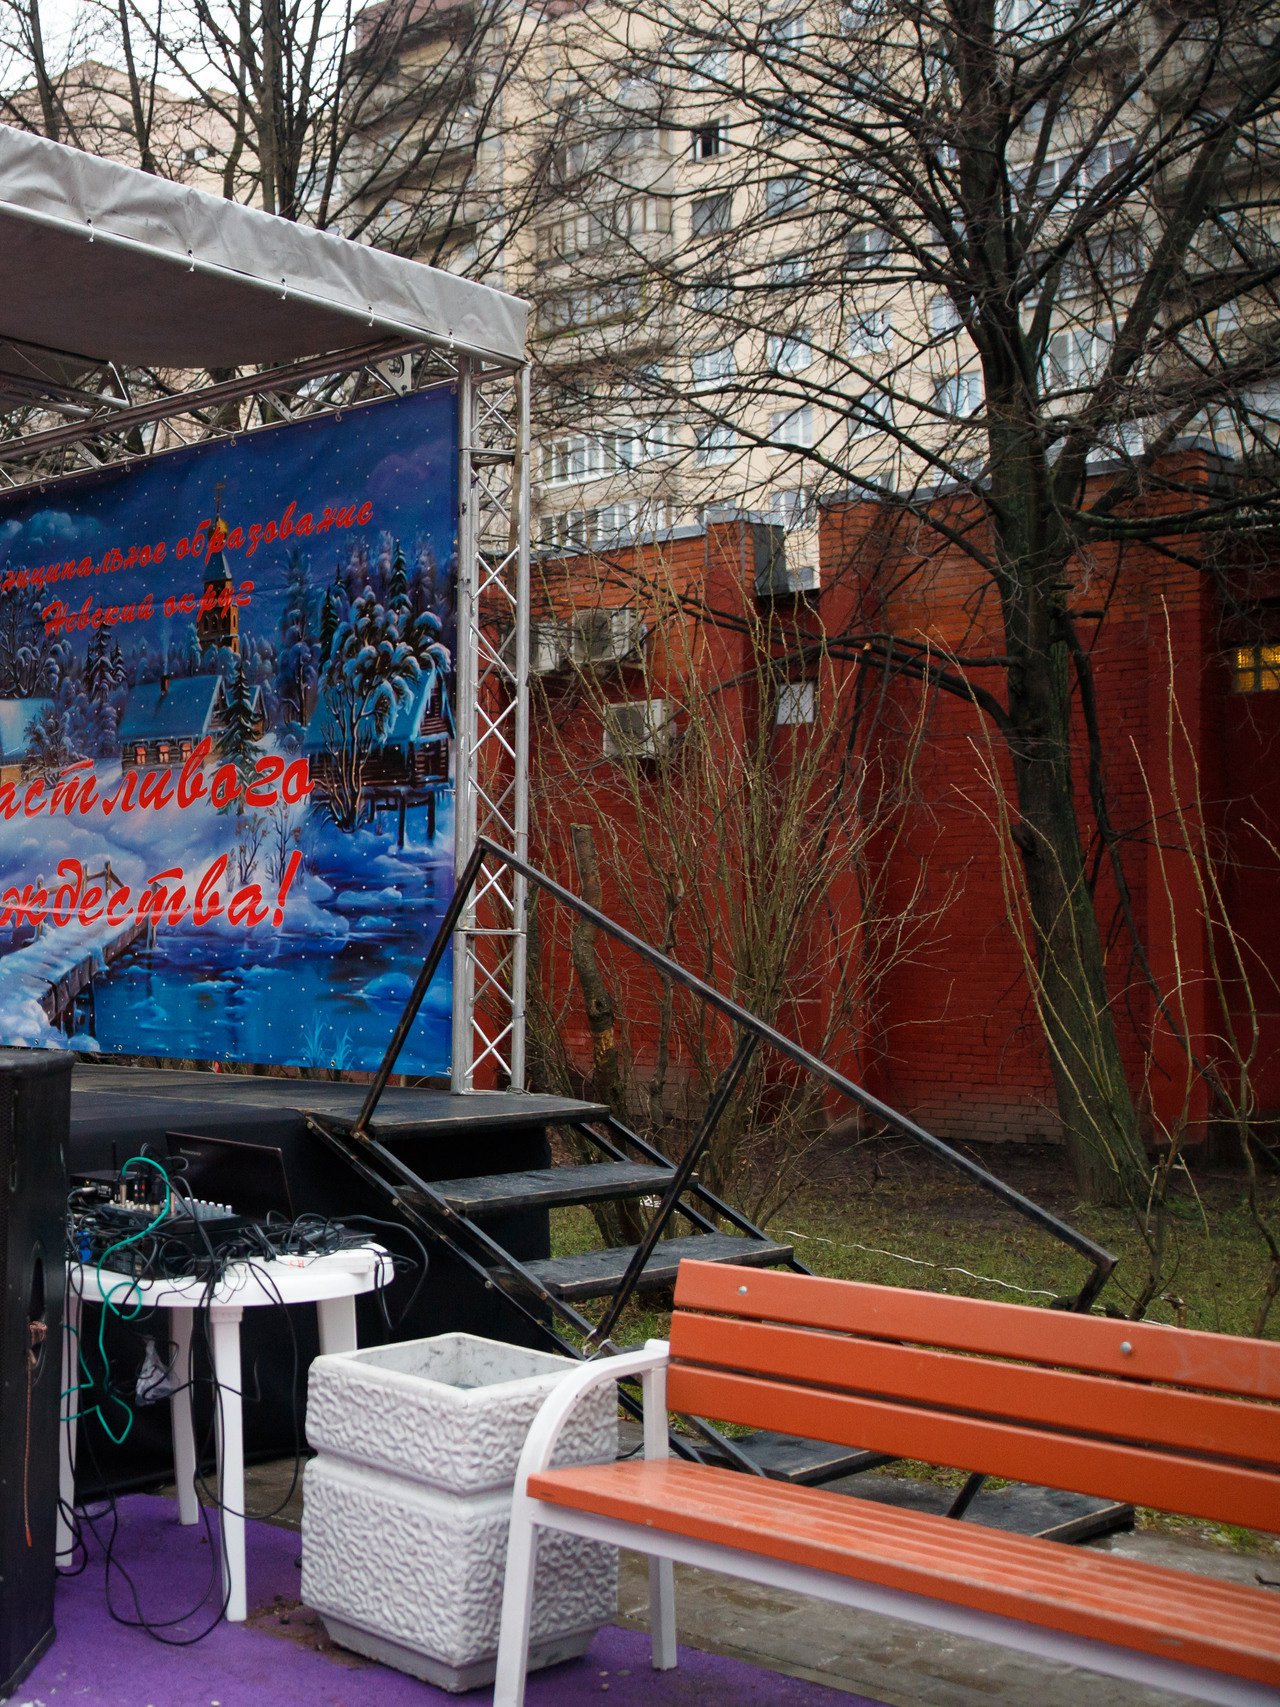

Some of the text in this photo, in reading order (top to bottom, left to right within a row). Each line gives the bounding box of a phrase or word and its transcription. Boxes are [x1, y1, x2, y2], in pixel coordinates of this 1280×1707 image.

[175, 500, 374, 565] образование
[41, 579, 256, 637] Невский округ
